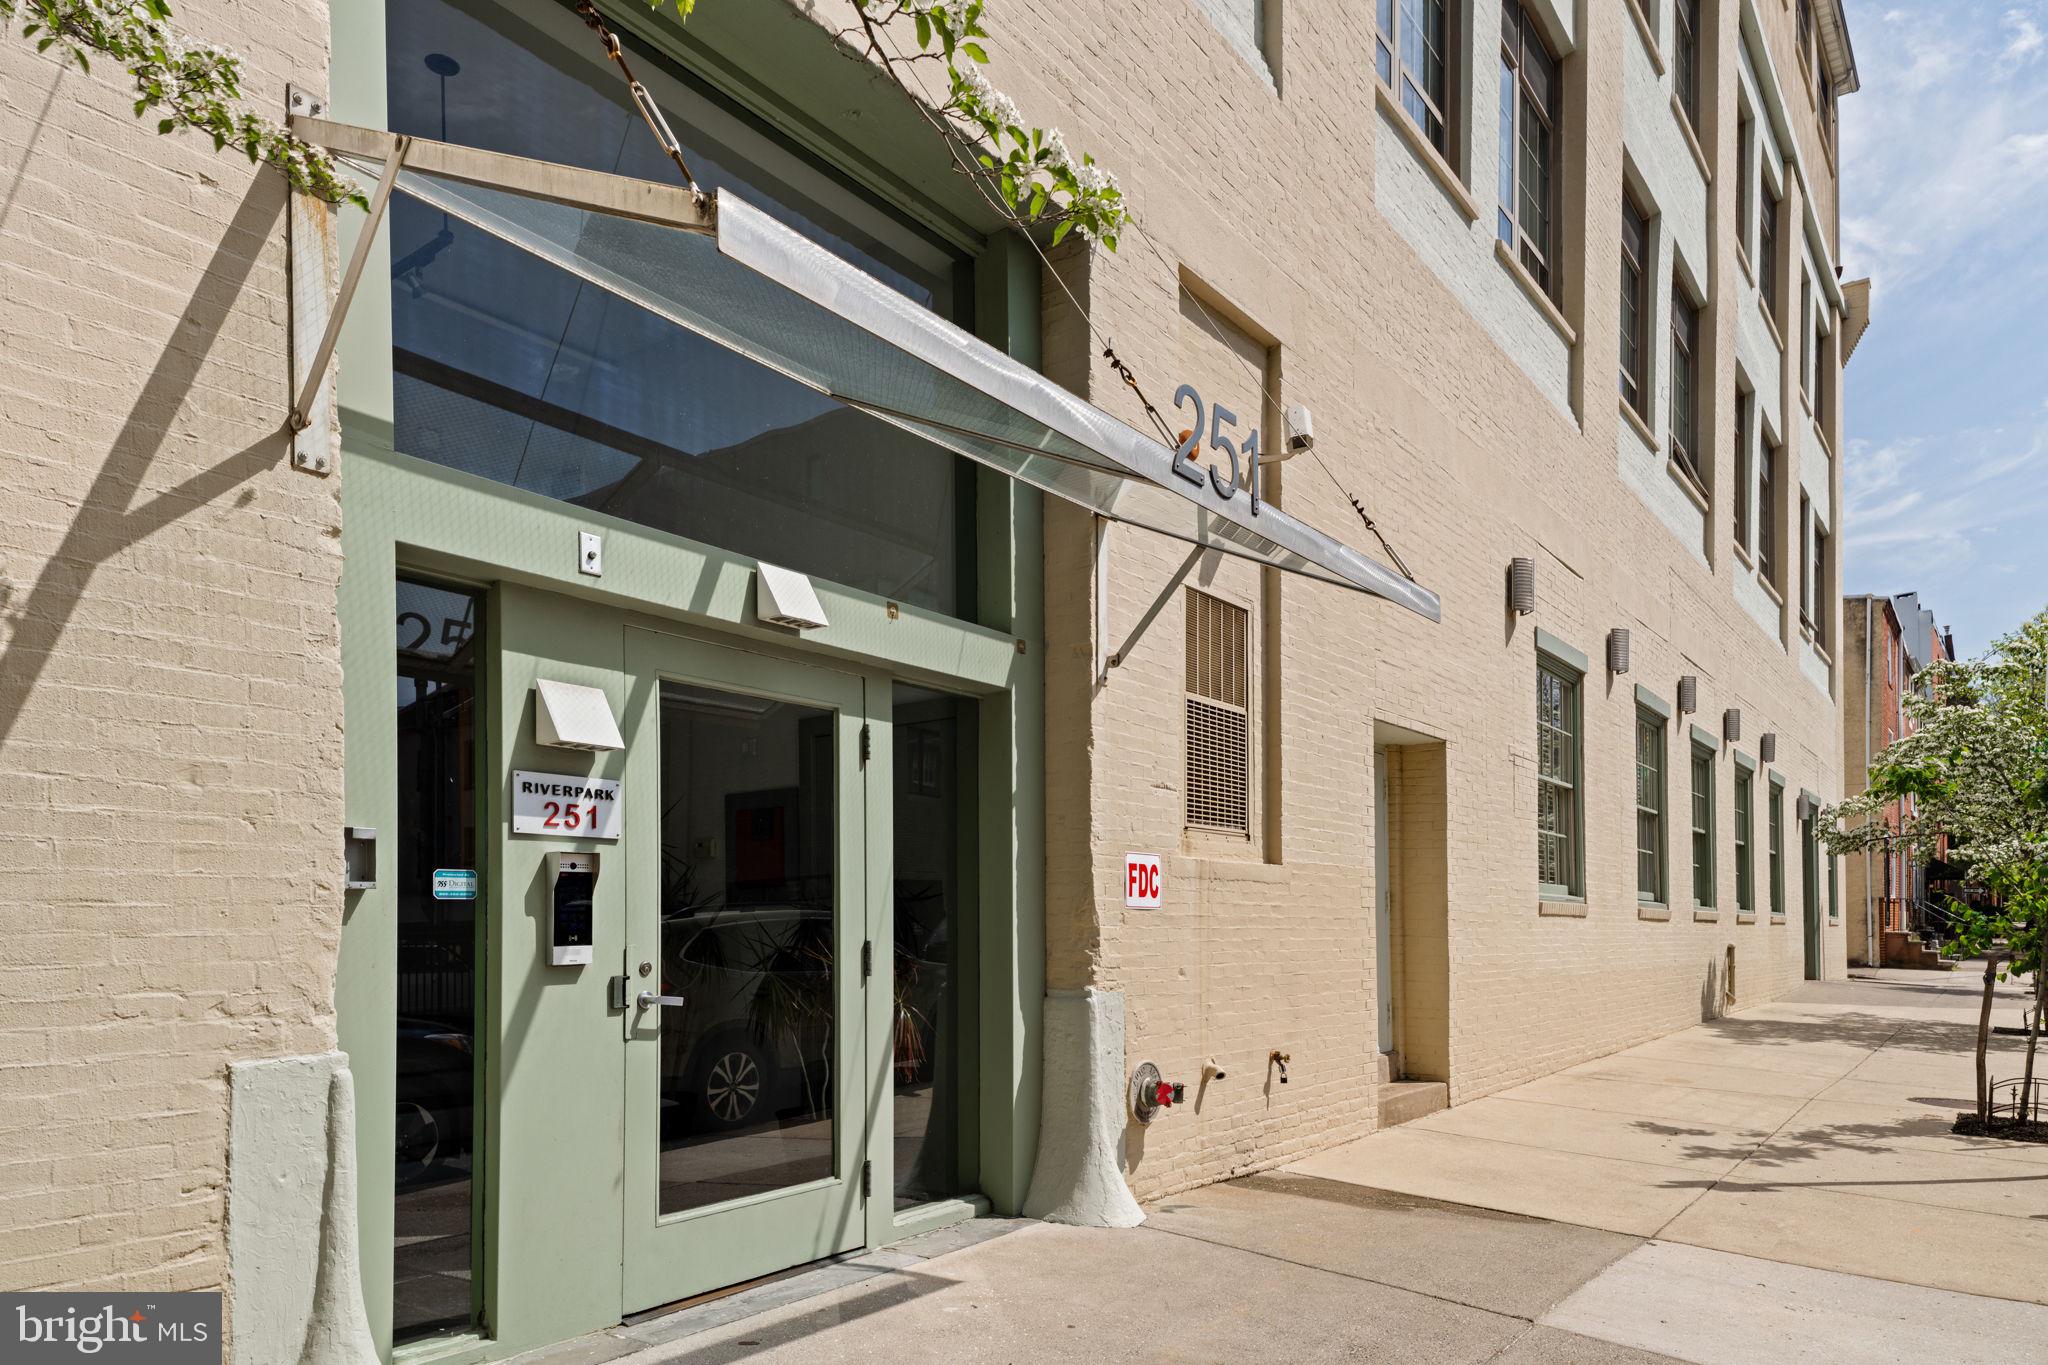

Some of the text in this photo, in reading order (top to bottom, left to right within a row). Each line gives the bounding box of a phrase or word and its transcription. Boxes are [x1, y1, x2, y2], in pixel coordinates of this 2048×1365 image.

[1172, 384, 1259, 517] 251
[522, 781, 615, 801] RIVERPARK
[543, 801, 599, 830] 251
[1128, 863, 1159, 899] FDC
